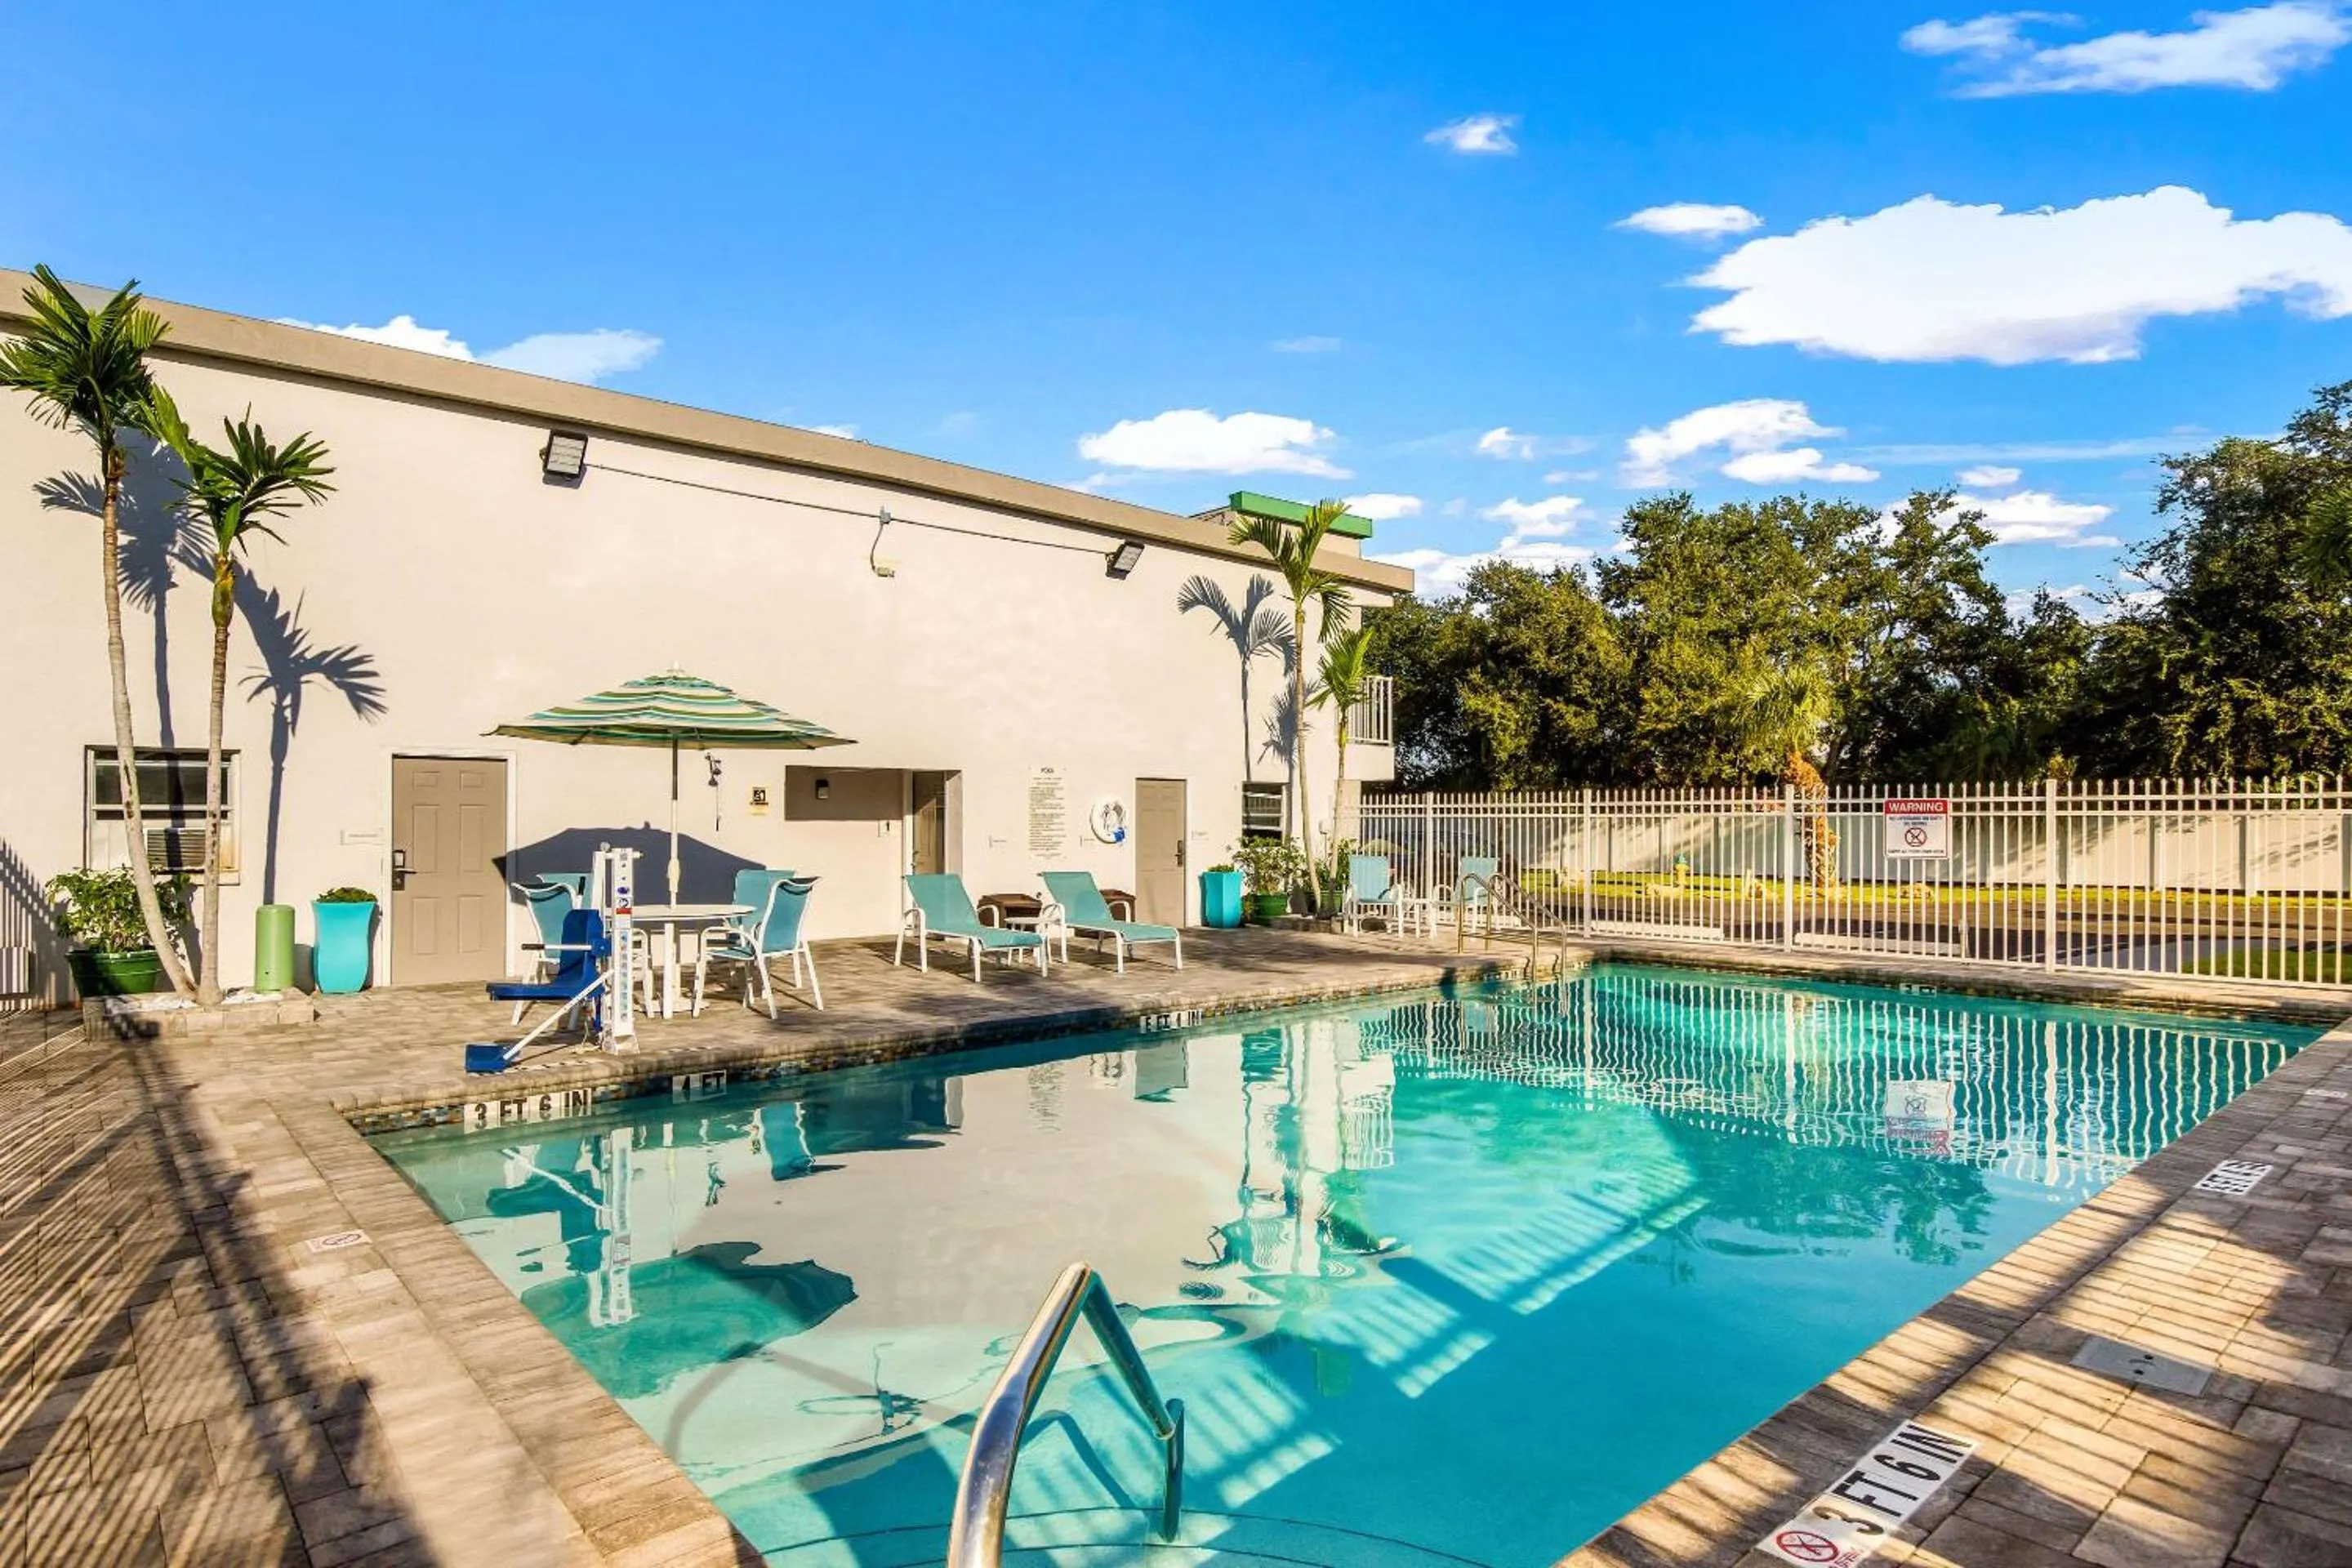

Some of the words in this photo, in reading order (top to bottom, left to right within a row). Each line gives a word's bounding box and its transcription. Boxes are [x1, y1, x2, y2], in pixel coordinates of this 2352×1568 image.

[1889, 803, 1944, 812] WARNING
[474, 1103, 488, 1120] 3
[500, 1098, 527, 1116] FT
[564, 1089, 588, 1107] IN
[1891, 1423, 1972, 1464] IN
[1873, 1454, 1941, 1481] 6
[1832, 1471, 1918, 1517] FT
[1811, 1506, 1884, 1535] 3
